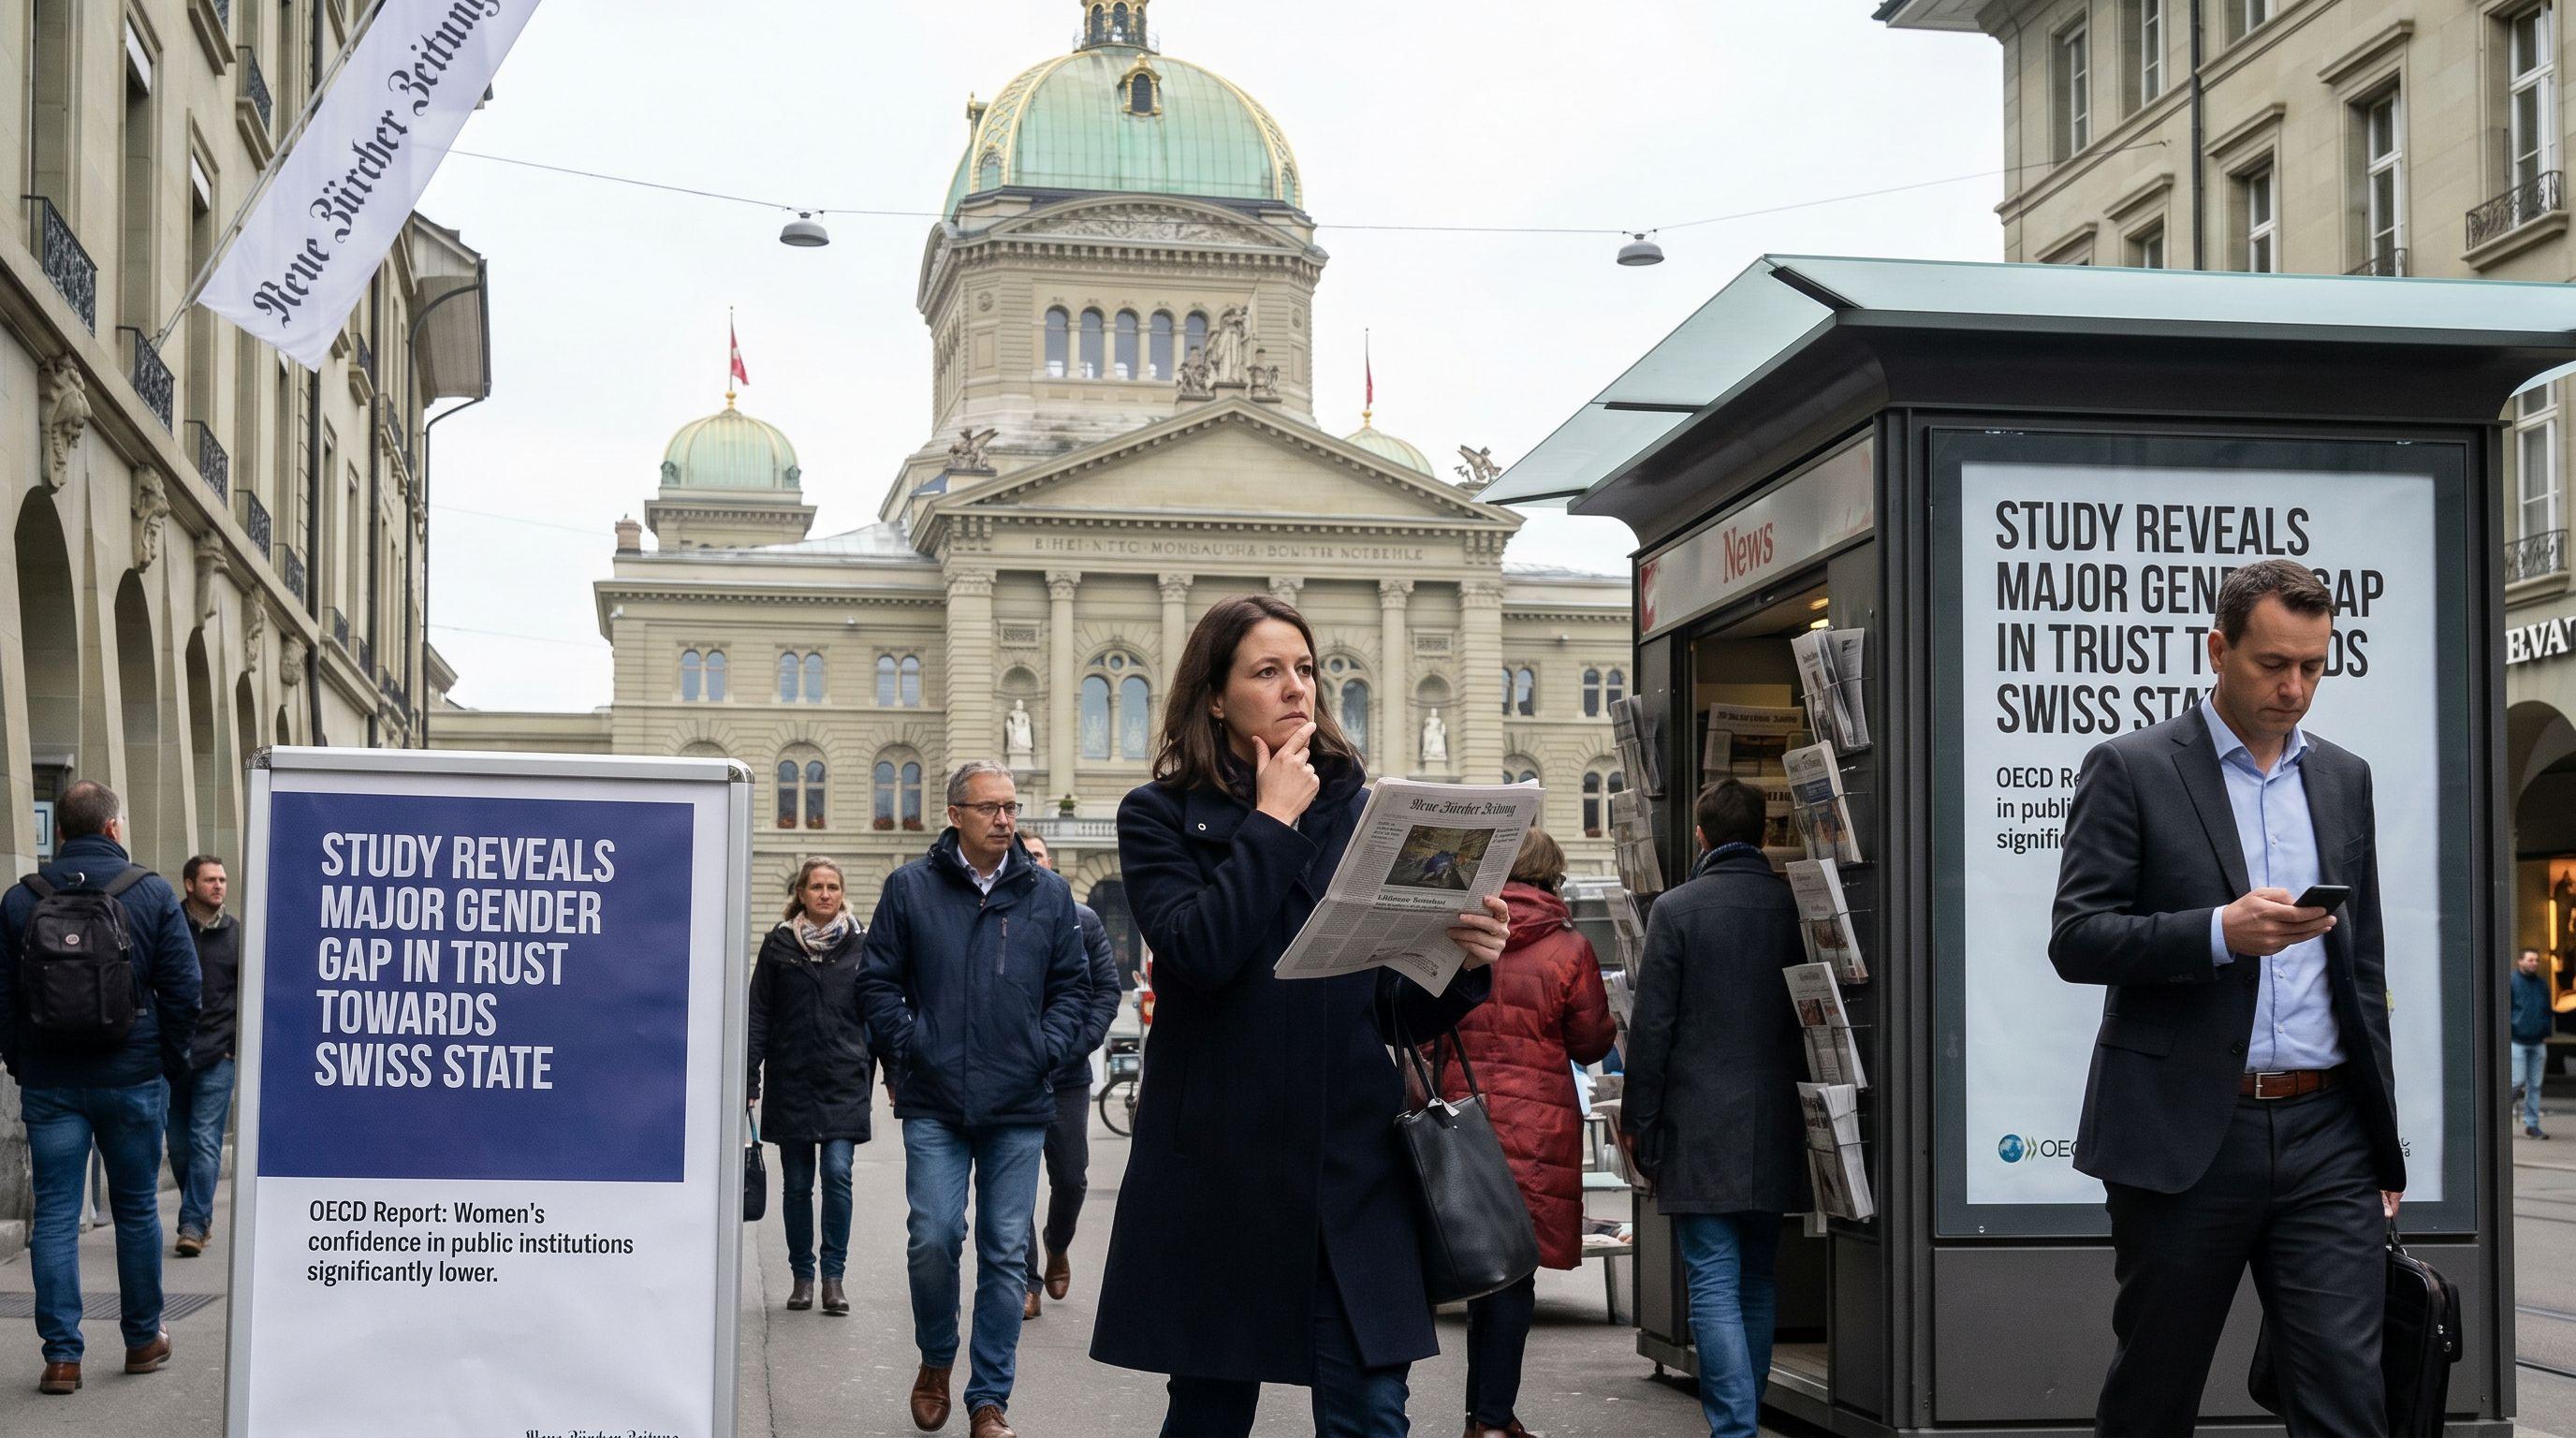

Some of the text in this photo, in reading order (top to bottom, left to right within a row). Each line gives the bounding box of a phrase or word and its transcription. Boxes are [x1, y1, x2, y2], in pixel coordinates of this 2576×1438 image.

[253, 239, 329, 329] Neue
[310, 110, 408, 243] Zürcher
[1723, 522, 1774, 583] News
[1996, 501, 2309, 556] STUDY REVEALS
[1998, 563, 2128, 612] MAJOR
[2142, 565, 2238, 614] GEN
[1998, 624, 2035, 672] IN
[2048, 624, 2174, 675] TRUST
[1997, 684, 2121, 734] SWISS
[1997, 767, 2053, 788] OECD
[1998, 798, 2071, 824] in publi
[322, 832, 616, 882] STUDY REVEALS
[321, 885, 602, 933] MAJOR GENDER
[319, 937, 568, 985] GAP IN TRUST
[316, 990, 497, 1035] TOWARDS
[315, 1042, 553, 1089] SWISS STATE
[2041, 1139, 2077, 1157] OE
[310, 1200, 545, 1228] OECD Report: Women's
[308, 1230, 634, 1258] confidence in public institutions
[307, 1260, 498, 1287] significantly lower.
